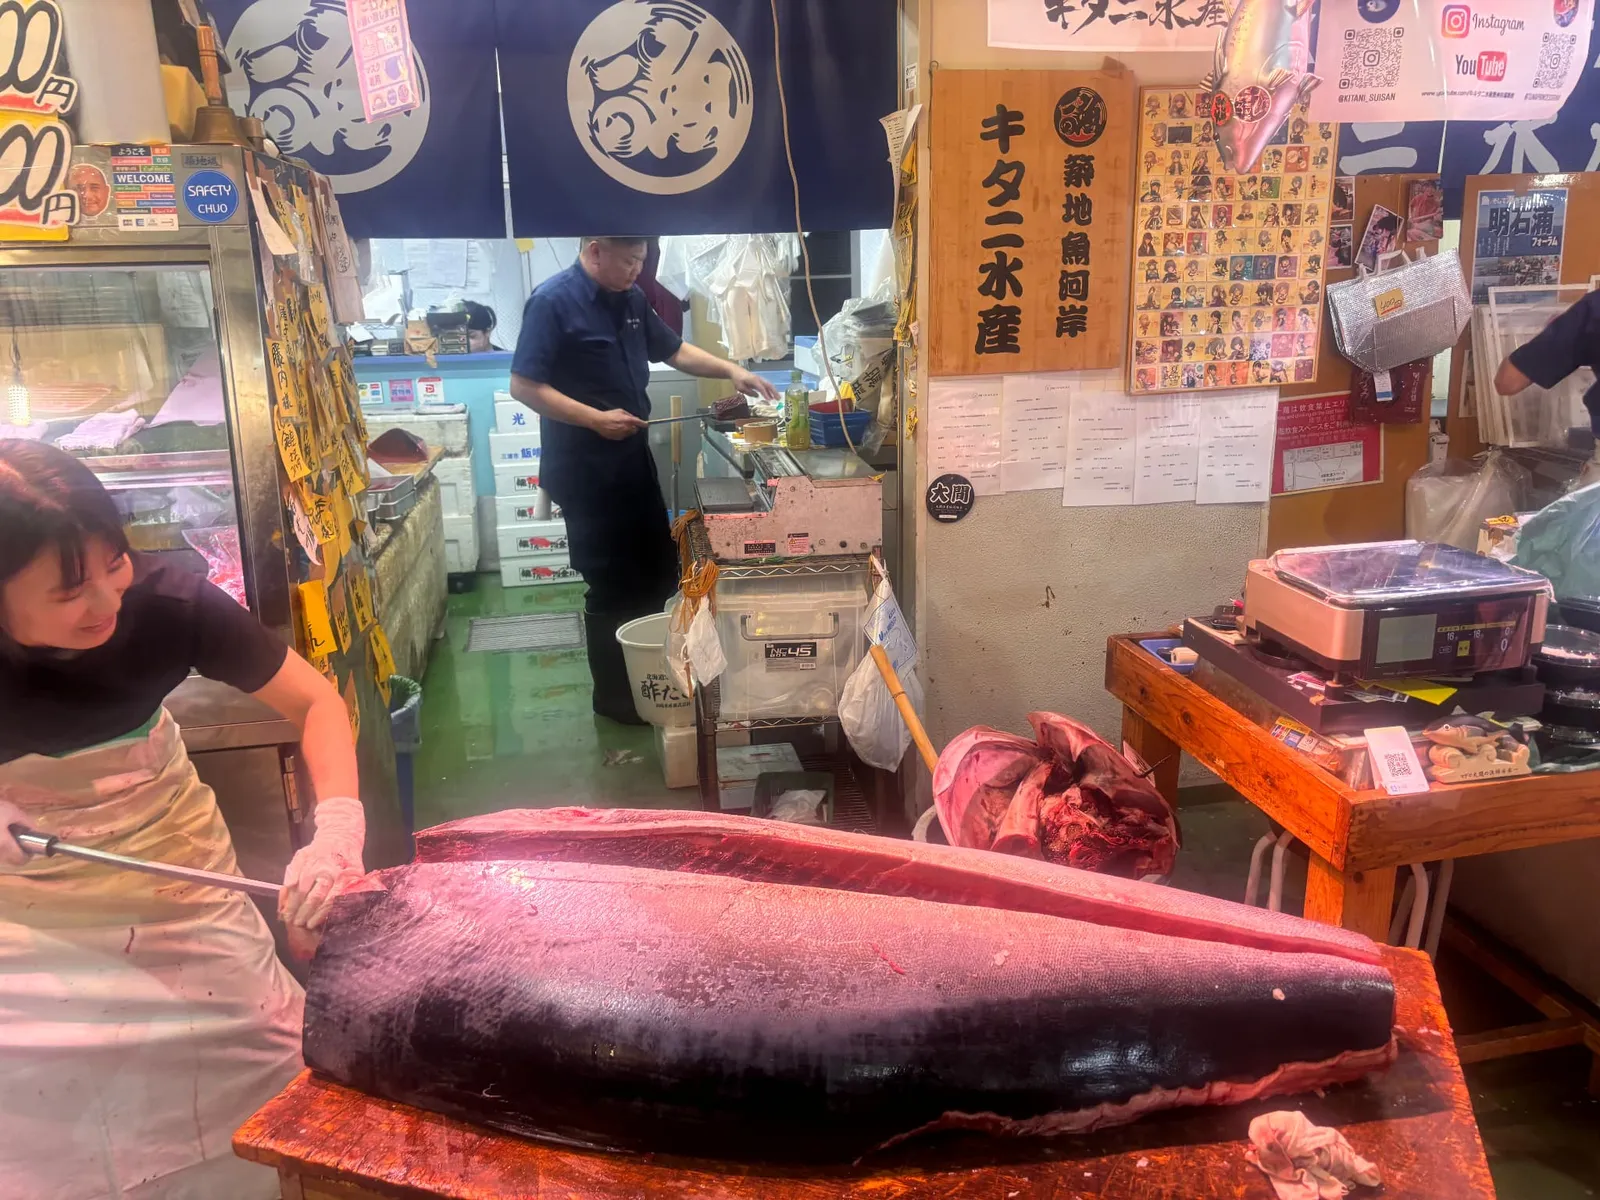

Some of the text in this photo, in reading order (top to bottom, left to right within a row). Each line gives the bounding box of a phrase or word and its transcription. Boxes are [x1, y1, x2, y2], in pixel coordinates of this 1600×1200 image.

[1472, 12, 1525, 36] Instagram
[1455, 53, 1506, 79] YouTube
[1338, 92, 1396, 103] @KITANI_SUISAN
[118, 147, 146, 156] ようこそ
[116, 174, 171, 183] WELCOME
[187, 184, 232, 197] SAFETY
[197, 203, 228, 214] CHUO
[974, 103, 1026, 355] キタニ水産
[1532, 236, 1558, 247] フォーラム
[512, 412, 526, 426] 光
[929, 482, 972, 504] 大間
[788, 647, 812, 657] 45
